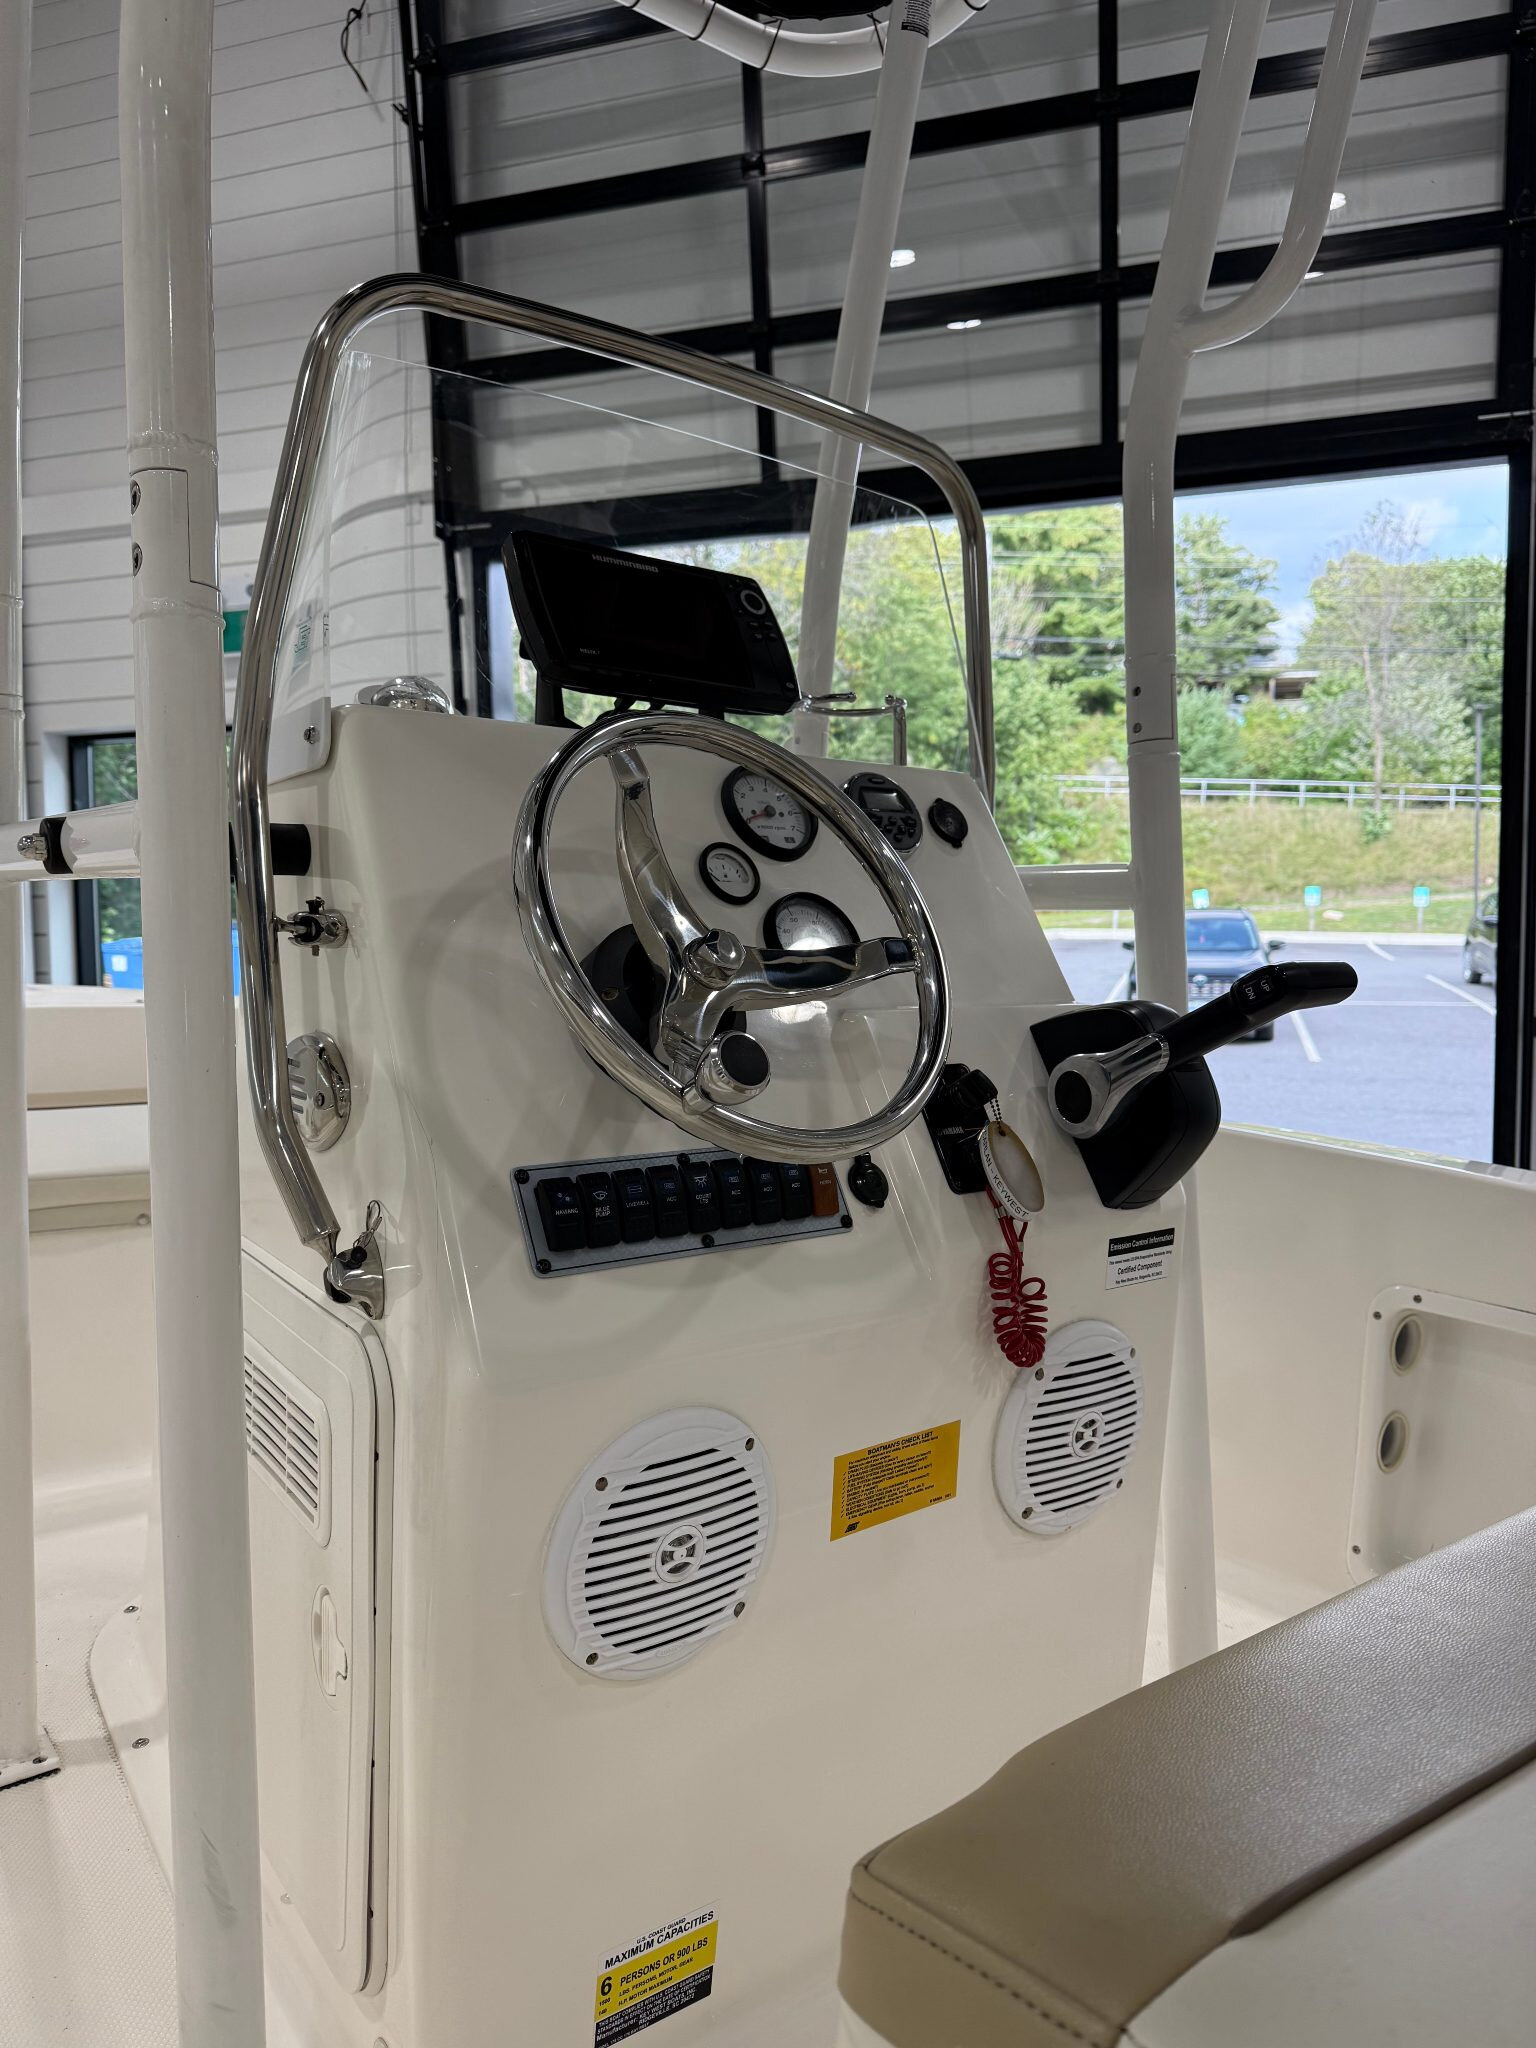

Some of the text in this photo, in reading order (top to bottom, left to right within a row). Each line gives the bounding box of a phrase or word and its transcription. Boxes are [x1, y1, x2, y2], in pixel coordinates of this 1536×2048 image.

[592, 554, 659, 573] HUMMINBIRD
[1245, 987, 1256, 1000] DN
[1261, 980, 1270, 991] UP
[993, 1174, 1029, 1217] KEYWEST
[1110, 1234, 1174, 1251] Emission Control Information
[1117, 1260, 1163, 1275] Certified Component
[868, 1431, 933, 1455] BOATMAN'S CHECK LIST
[605, 1911, 714, 1969] MAXIMUM CAPACITIES
[600, 1937, 708, 1997] 6 PERSONS OR 900 LBS
[596, 2017, 637, 2041] Manufacturer:
